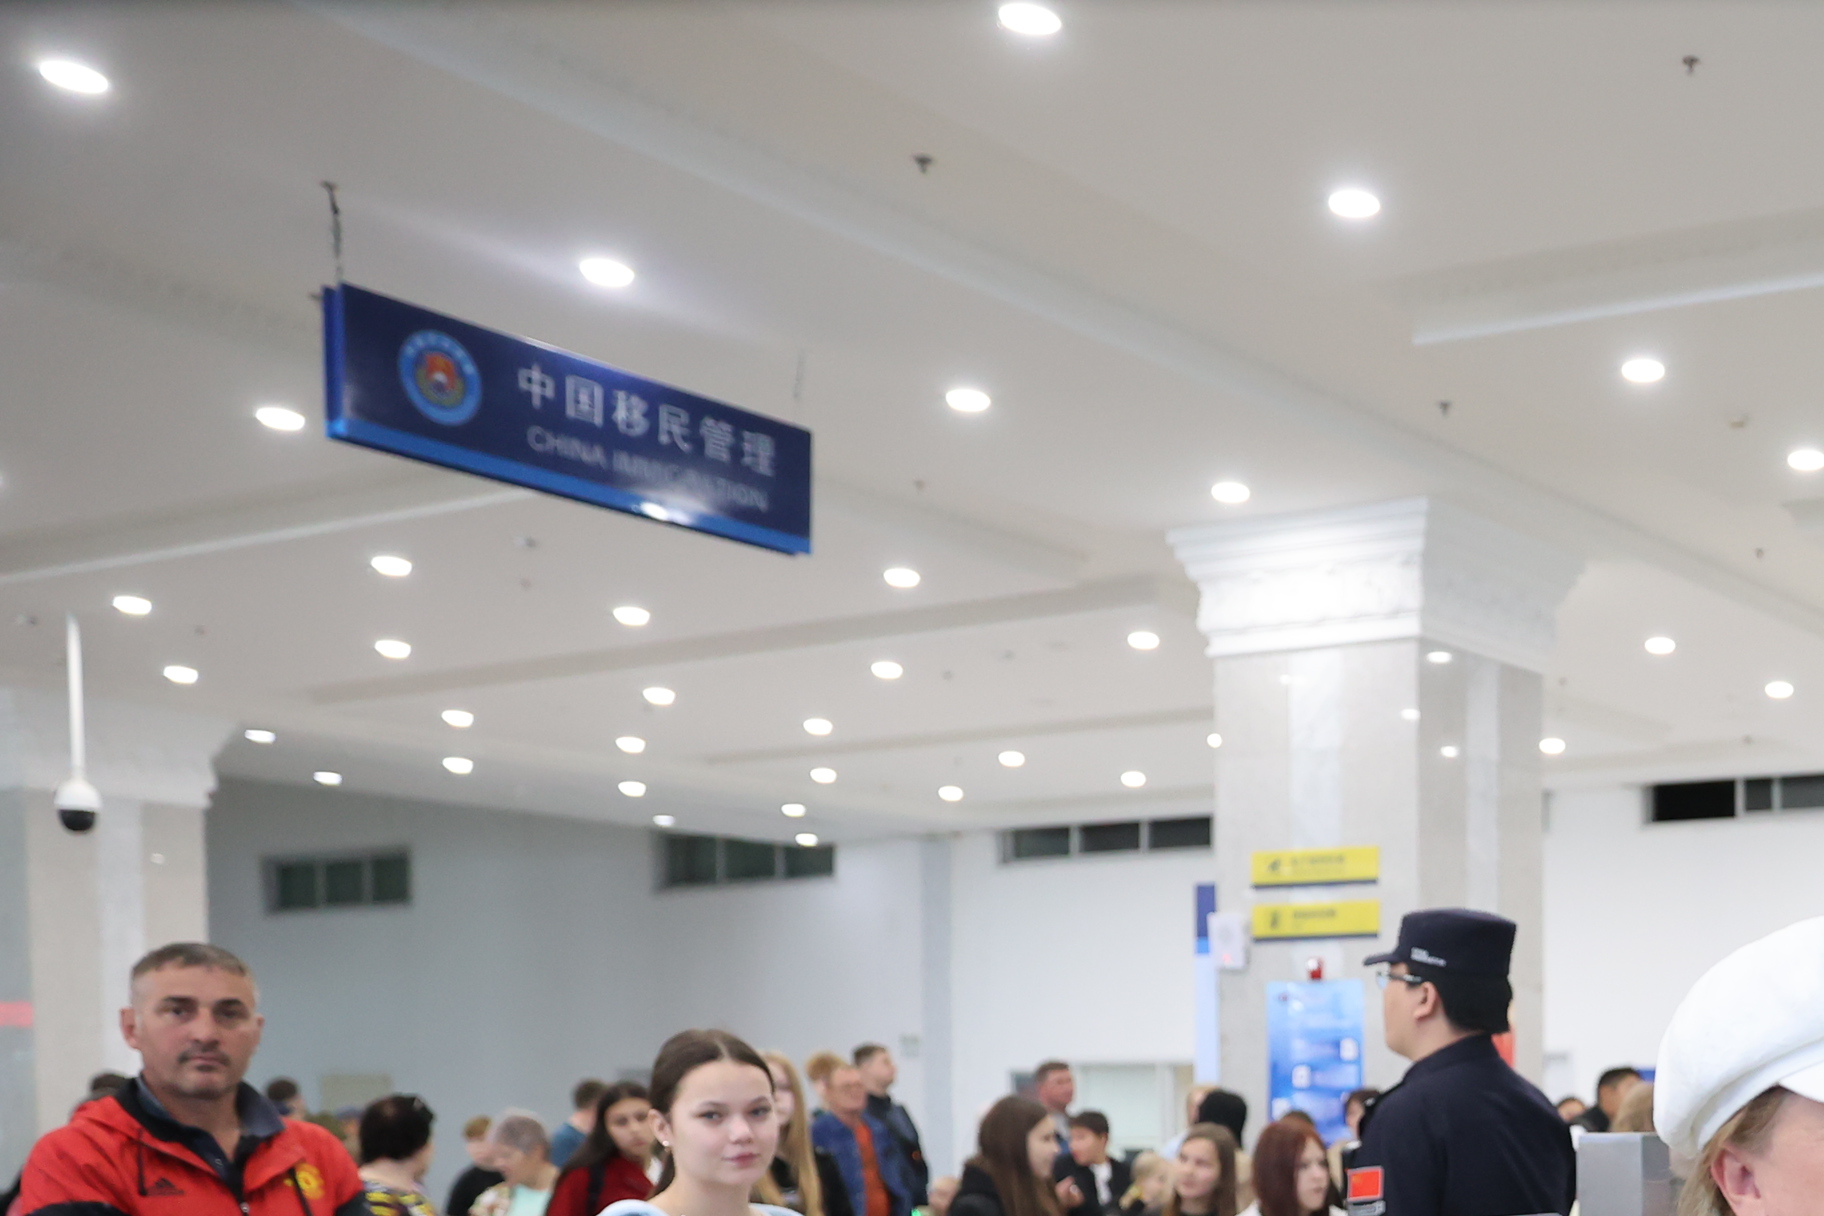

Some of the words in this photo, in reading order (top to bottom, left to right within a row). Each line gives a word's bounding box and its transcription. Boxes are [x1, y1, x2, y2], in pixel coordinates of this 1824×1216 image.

[517, 363, 775, 477] 中国移民管理
[526, 425, 607, 469] CHINA
